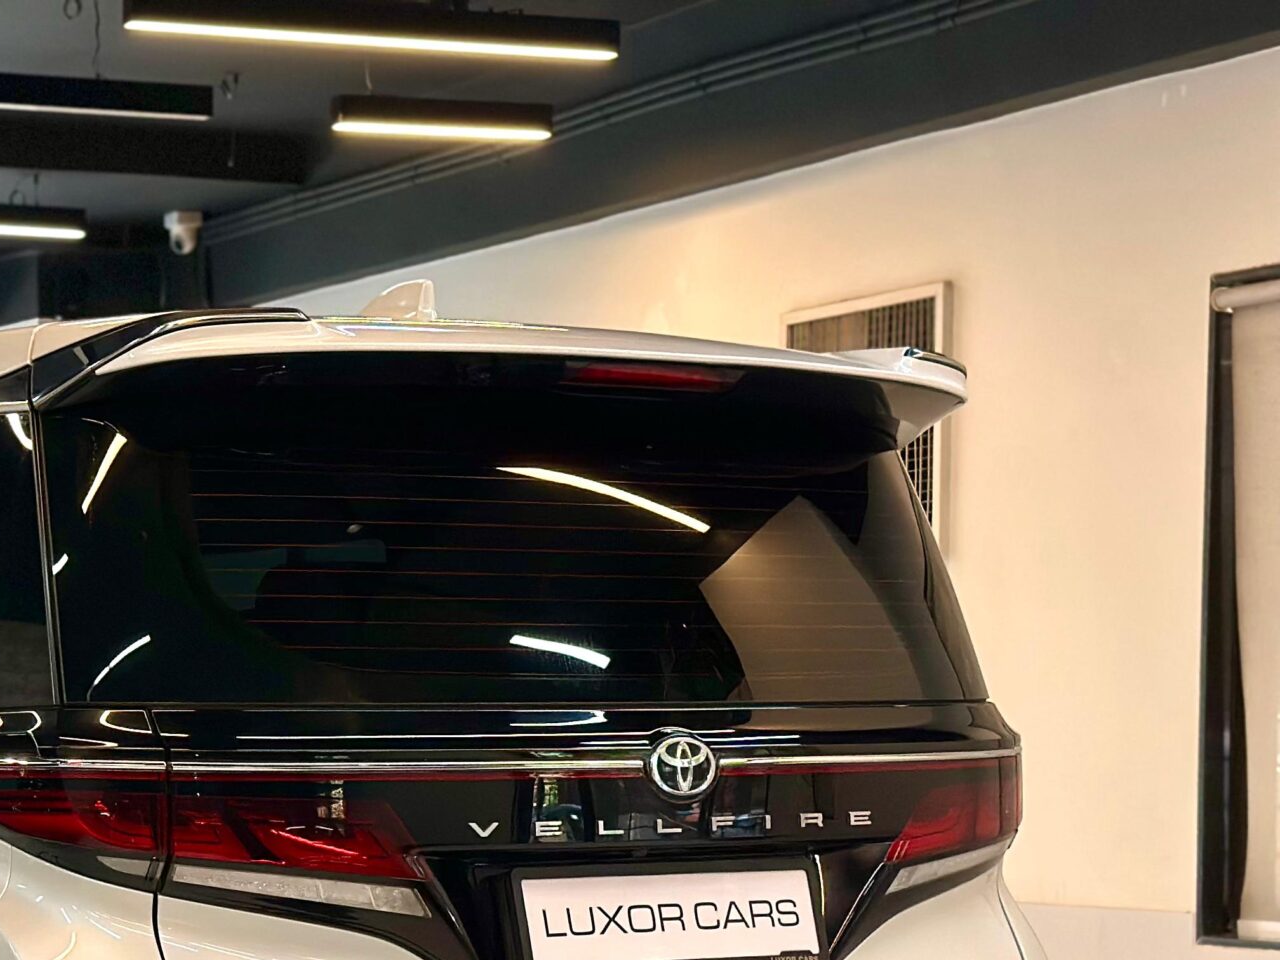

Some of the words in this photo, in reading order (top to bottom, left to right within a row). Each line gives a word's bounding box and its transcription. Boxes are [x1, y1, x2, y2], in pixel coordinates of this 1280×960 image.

[468, 811, 872, 838] VELLFIRE
[541, 904, 686, 938] LUXOR
[694, 899, 800, 931] CARS
